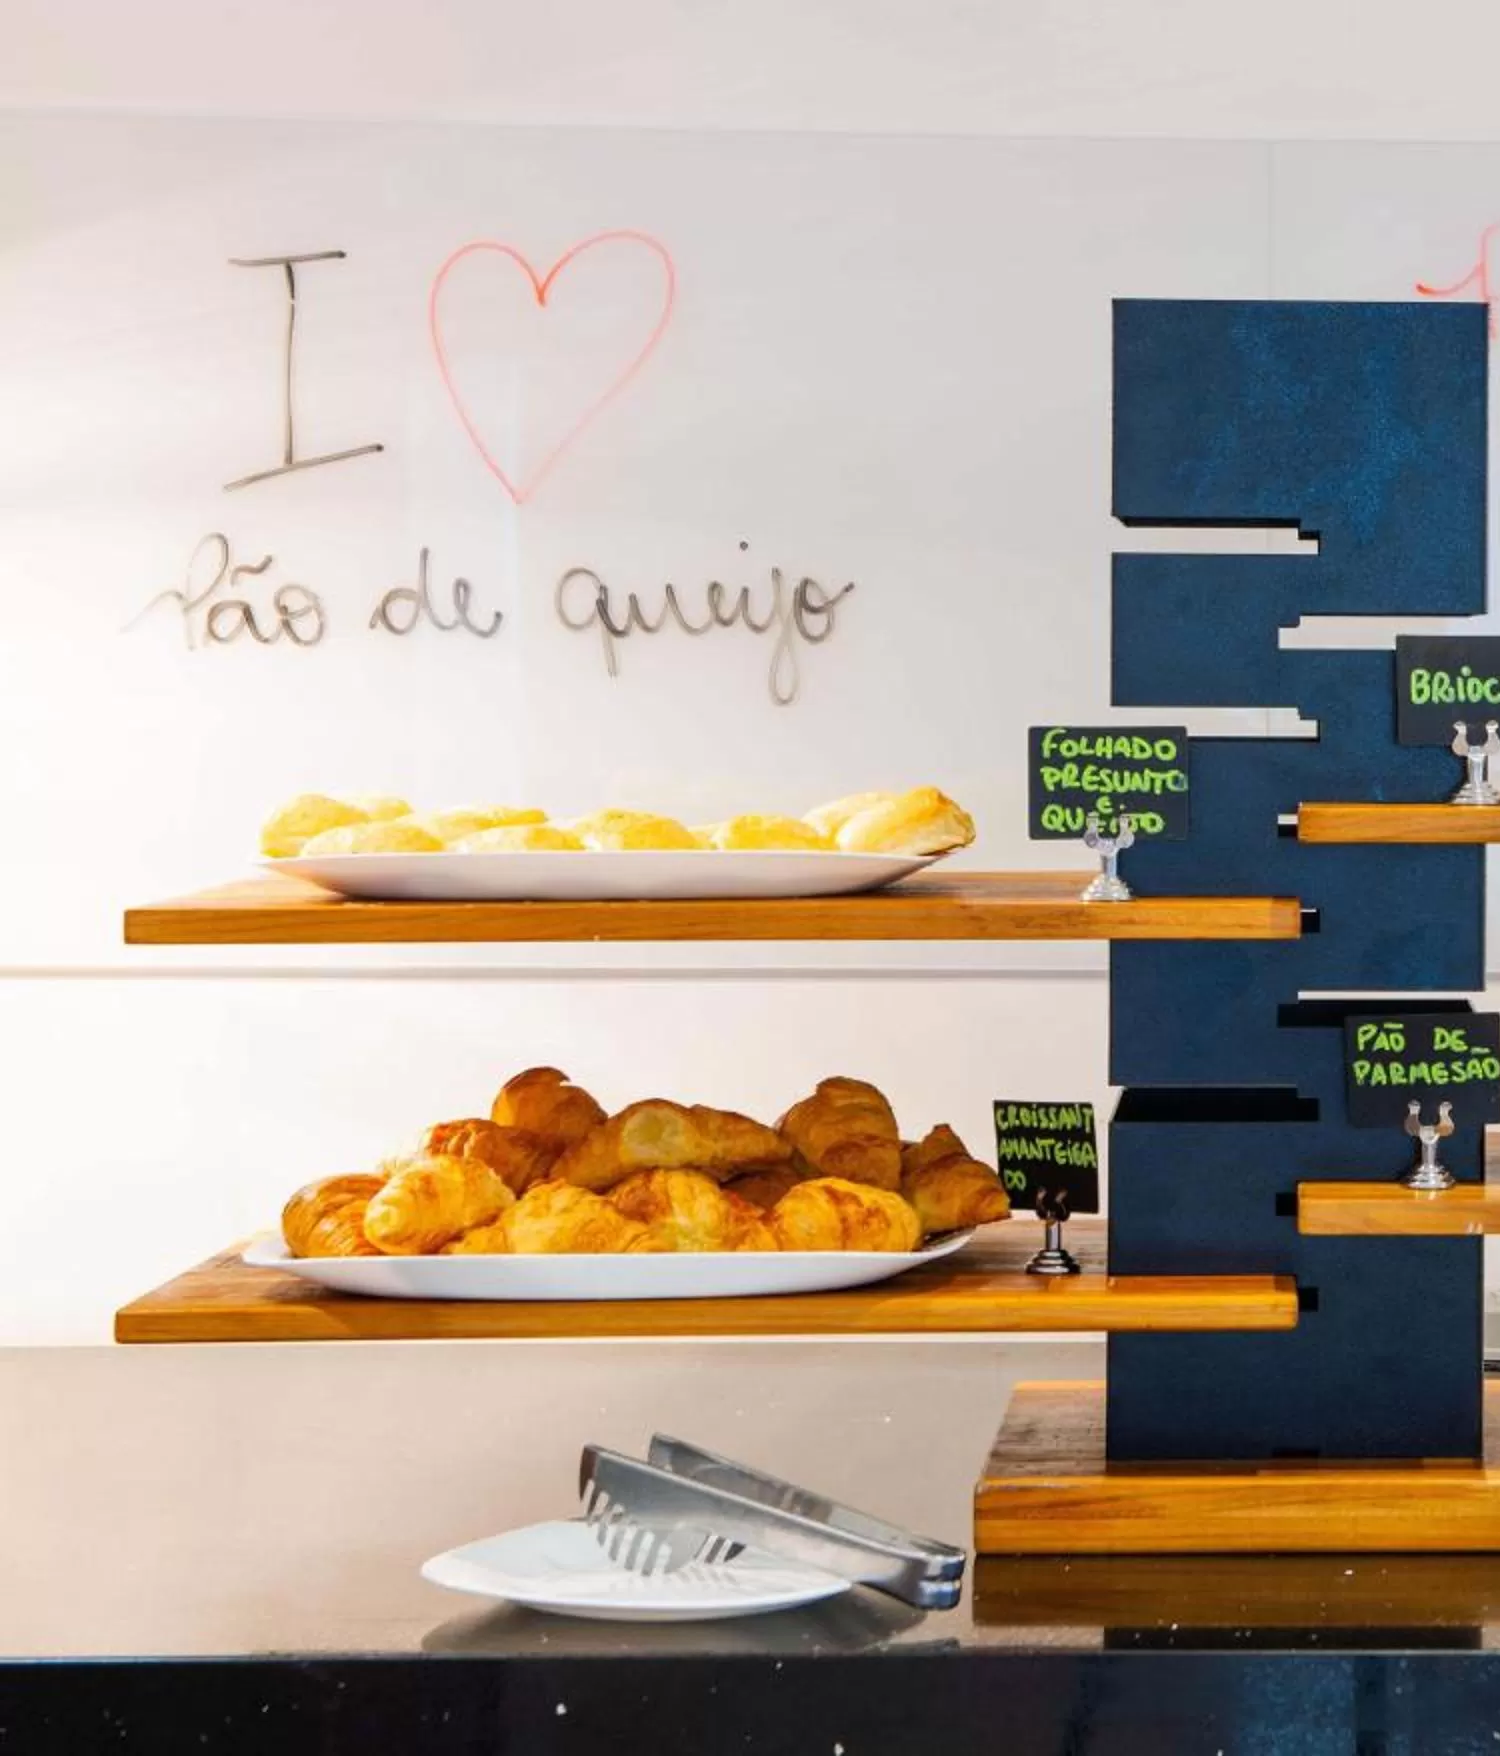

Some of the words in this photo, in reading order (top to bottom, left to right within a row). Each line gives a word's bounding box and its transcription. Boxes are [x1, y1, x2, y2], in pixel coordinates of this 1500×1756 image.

[224, 249, 386, 491] I
[118, 530, 325, 651] Pão
[368, 545, 505, 638] de
[554, 538, 856, 706] queijo
[1041, 726, 1178, 762] FOLHADO
[1039, 761, 1189, 795] PRESUNTO
[1432, 1026, 1469, 1053] DE
[1003, 1167, 1027, 1192] DO
